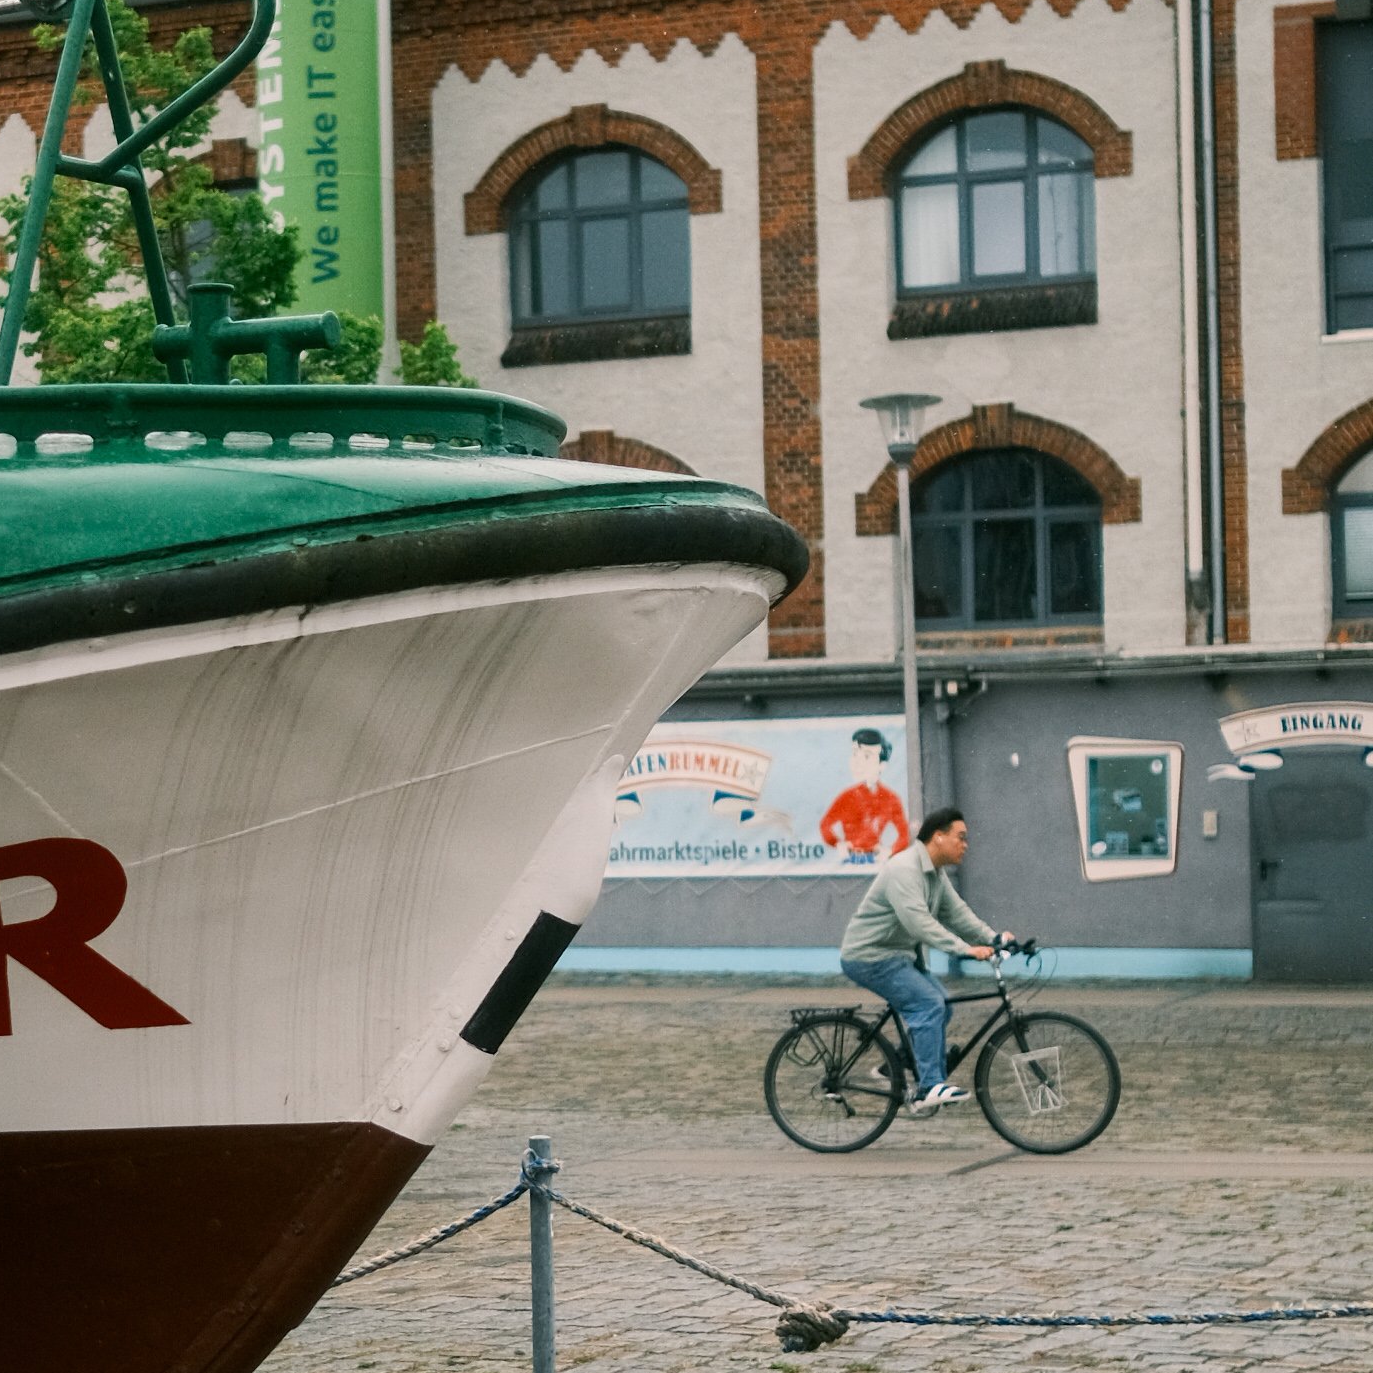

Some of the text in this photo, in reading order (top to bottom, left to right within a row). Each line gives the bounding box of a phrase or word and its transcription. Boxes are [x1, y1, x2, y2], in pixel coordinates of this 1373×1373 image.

[307, 65, 336, 99] IT
[306, 113, 339, 211] make
[310, 225, 340, 284] We
[1280, 712, 1363, 733] EINGANG
[628, 751, 739, 777] AFENRUMMEL
[609, 839, 825, 865] ahrmarktspiele Bistro
